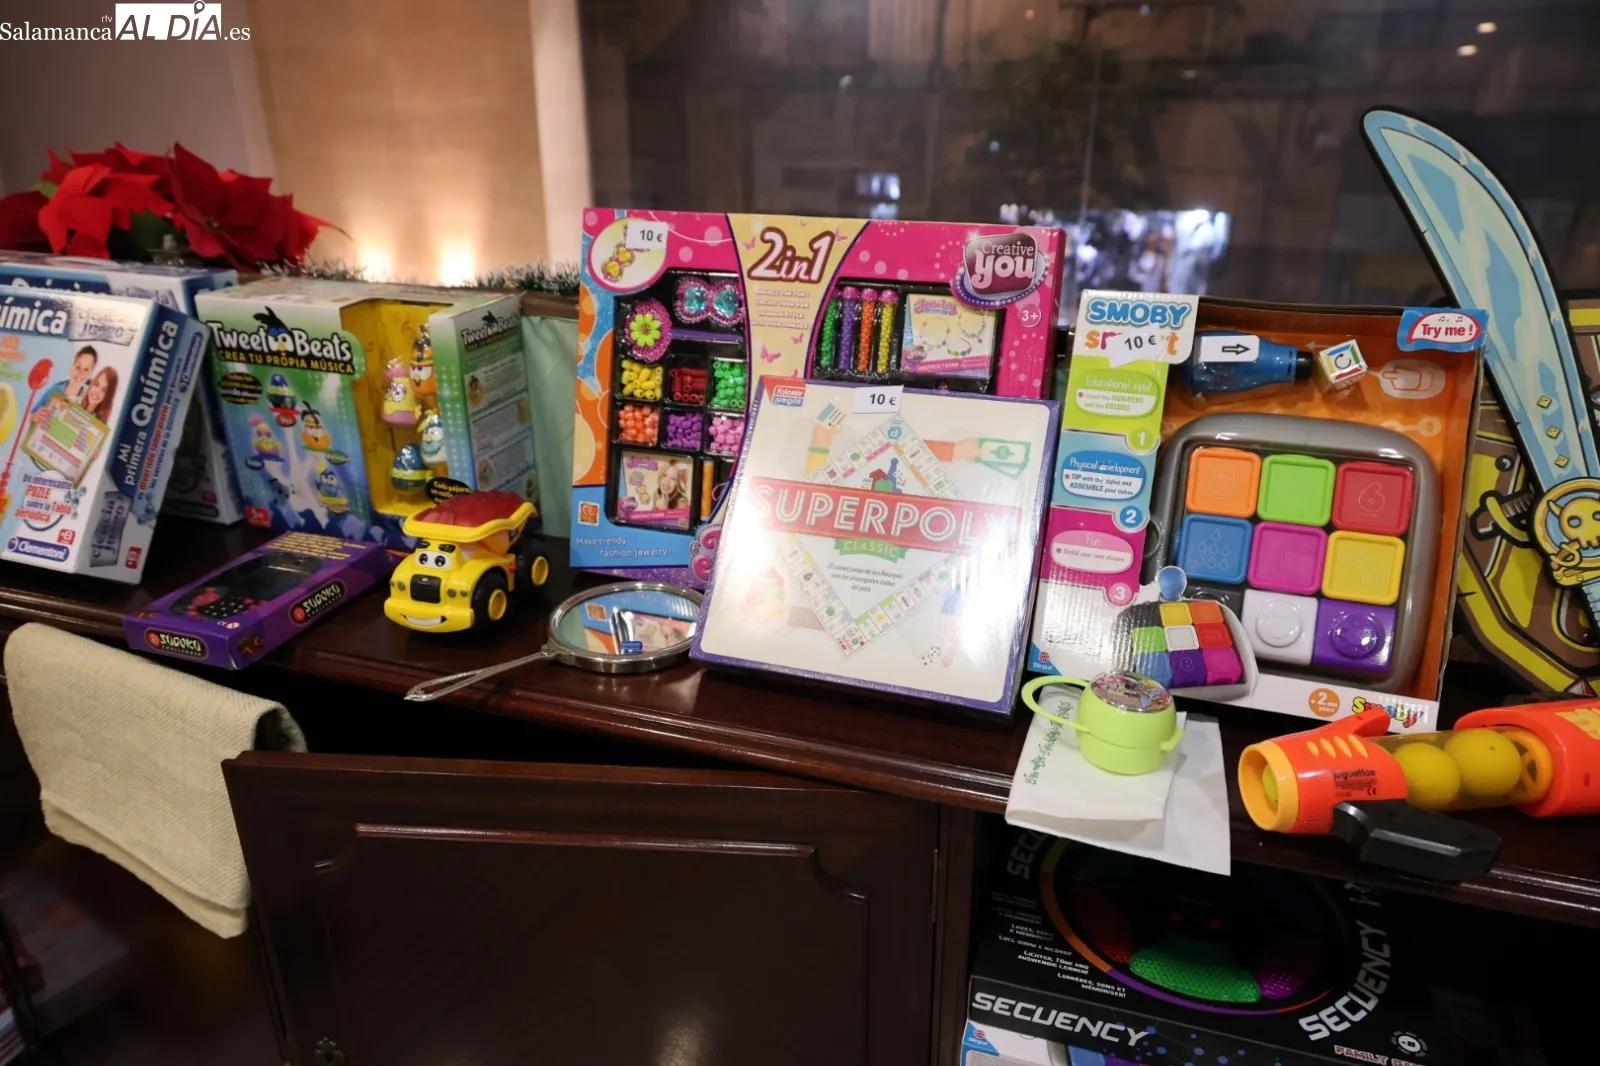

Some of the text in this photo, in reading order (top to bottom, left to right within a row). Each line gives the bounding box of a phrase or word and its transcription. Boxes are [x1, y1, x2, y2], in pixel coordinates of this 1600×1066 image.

[639, 229, 663, 243] 10 €
[748, 227, 834, 283] 2in1
[982, 240, 1034, 256] Creative
[971, 248, 1036, 289] you
[1021, 310, 1038, 322] 3+
[1087, 298, 1191, 329] SMOBY
[1421, 323, 1441, 339] Try
[1444, 326, 1466, 337] me
[207, 322, 351, 362] Tweet Beats
[1124, 335, 1157, 351] 10 €
[219, 350, 246, 362] CREA
[248, 353, 263, 364] TU
[131, 319, 179, 427] Química
[1085, 376, 1131, 391] Educational
[774, 397, 802, 406] juegos
[870, 393, 897, 406] 10 €
[1105, 403, 1131, 411] COLORS
[1111, 395, 1144, 404] NUMBERS
[1137, 431, 1146, 446] 1
[118, 443, 131, 461] Mi
[124, 431, 147, 486] primera
[1070, 457, 1142, 476] Physical development
[1070, 482, 1104, 492] ASSEMBLE
[1125, 509, 1137, 524] 2
[598, 537, 627, 546] trendy
[1085, 532, 1101, 546] Fun
[600, 548, 632, 557] fashion
[844, 540, 897, 558] CLASSIC
[302, 584, 340, 613] SUDOKU
[1114, 586, 1126, 601] 3
[160, 633, 202, 651] SUDOKU
[1018, 955, 1057, 968] AUSWENDIG
[1096, 982, 1115, 991] SONS
[1298, 918, 1392, 1041] SECUENCY
[972, 992, 1149, 1047] SECUENCY
[1334, 1044, 1388, 1066] FAMILY
